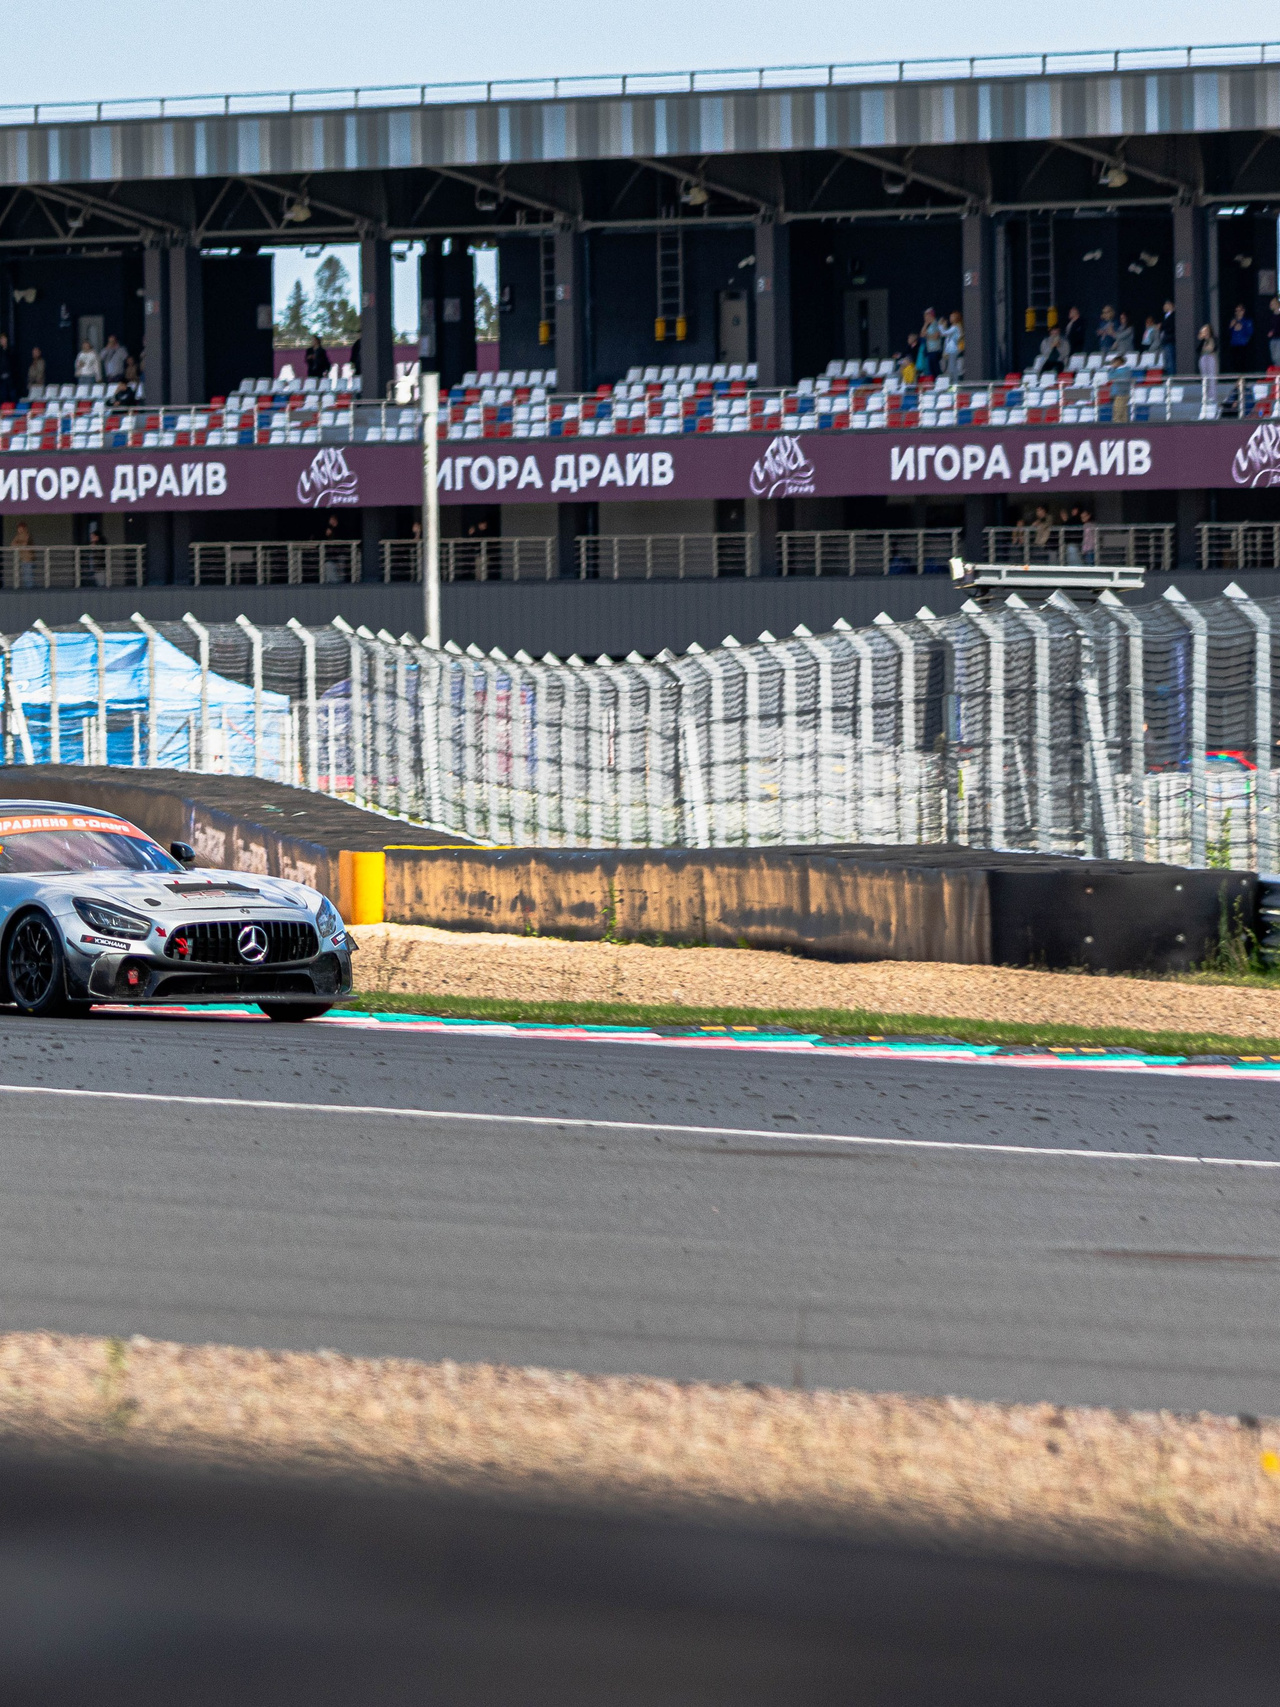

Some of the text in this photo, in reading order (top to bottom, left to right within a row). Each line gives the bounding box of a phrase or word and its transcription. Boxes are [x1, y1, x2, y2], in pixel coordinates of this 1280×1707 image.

[437, 451, 675, 493] ИГОРА ДРАЙВ
[890, 439, 1152, 484] ИГОРА ДРАЙВ
[110, 462, 228, 504] ДРАЙВ
[94, 937, 127, 950] YOKOHAMA
